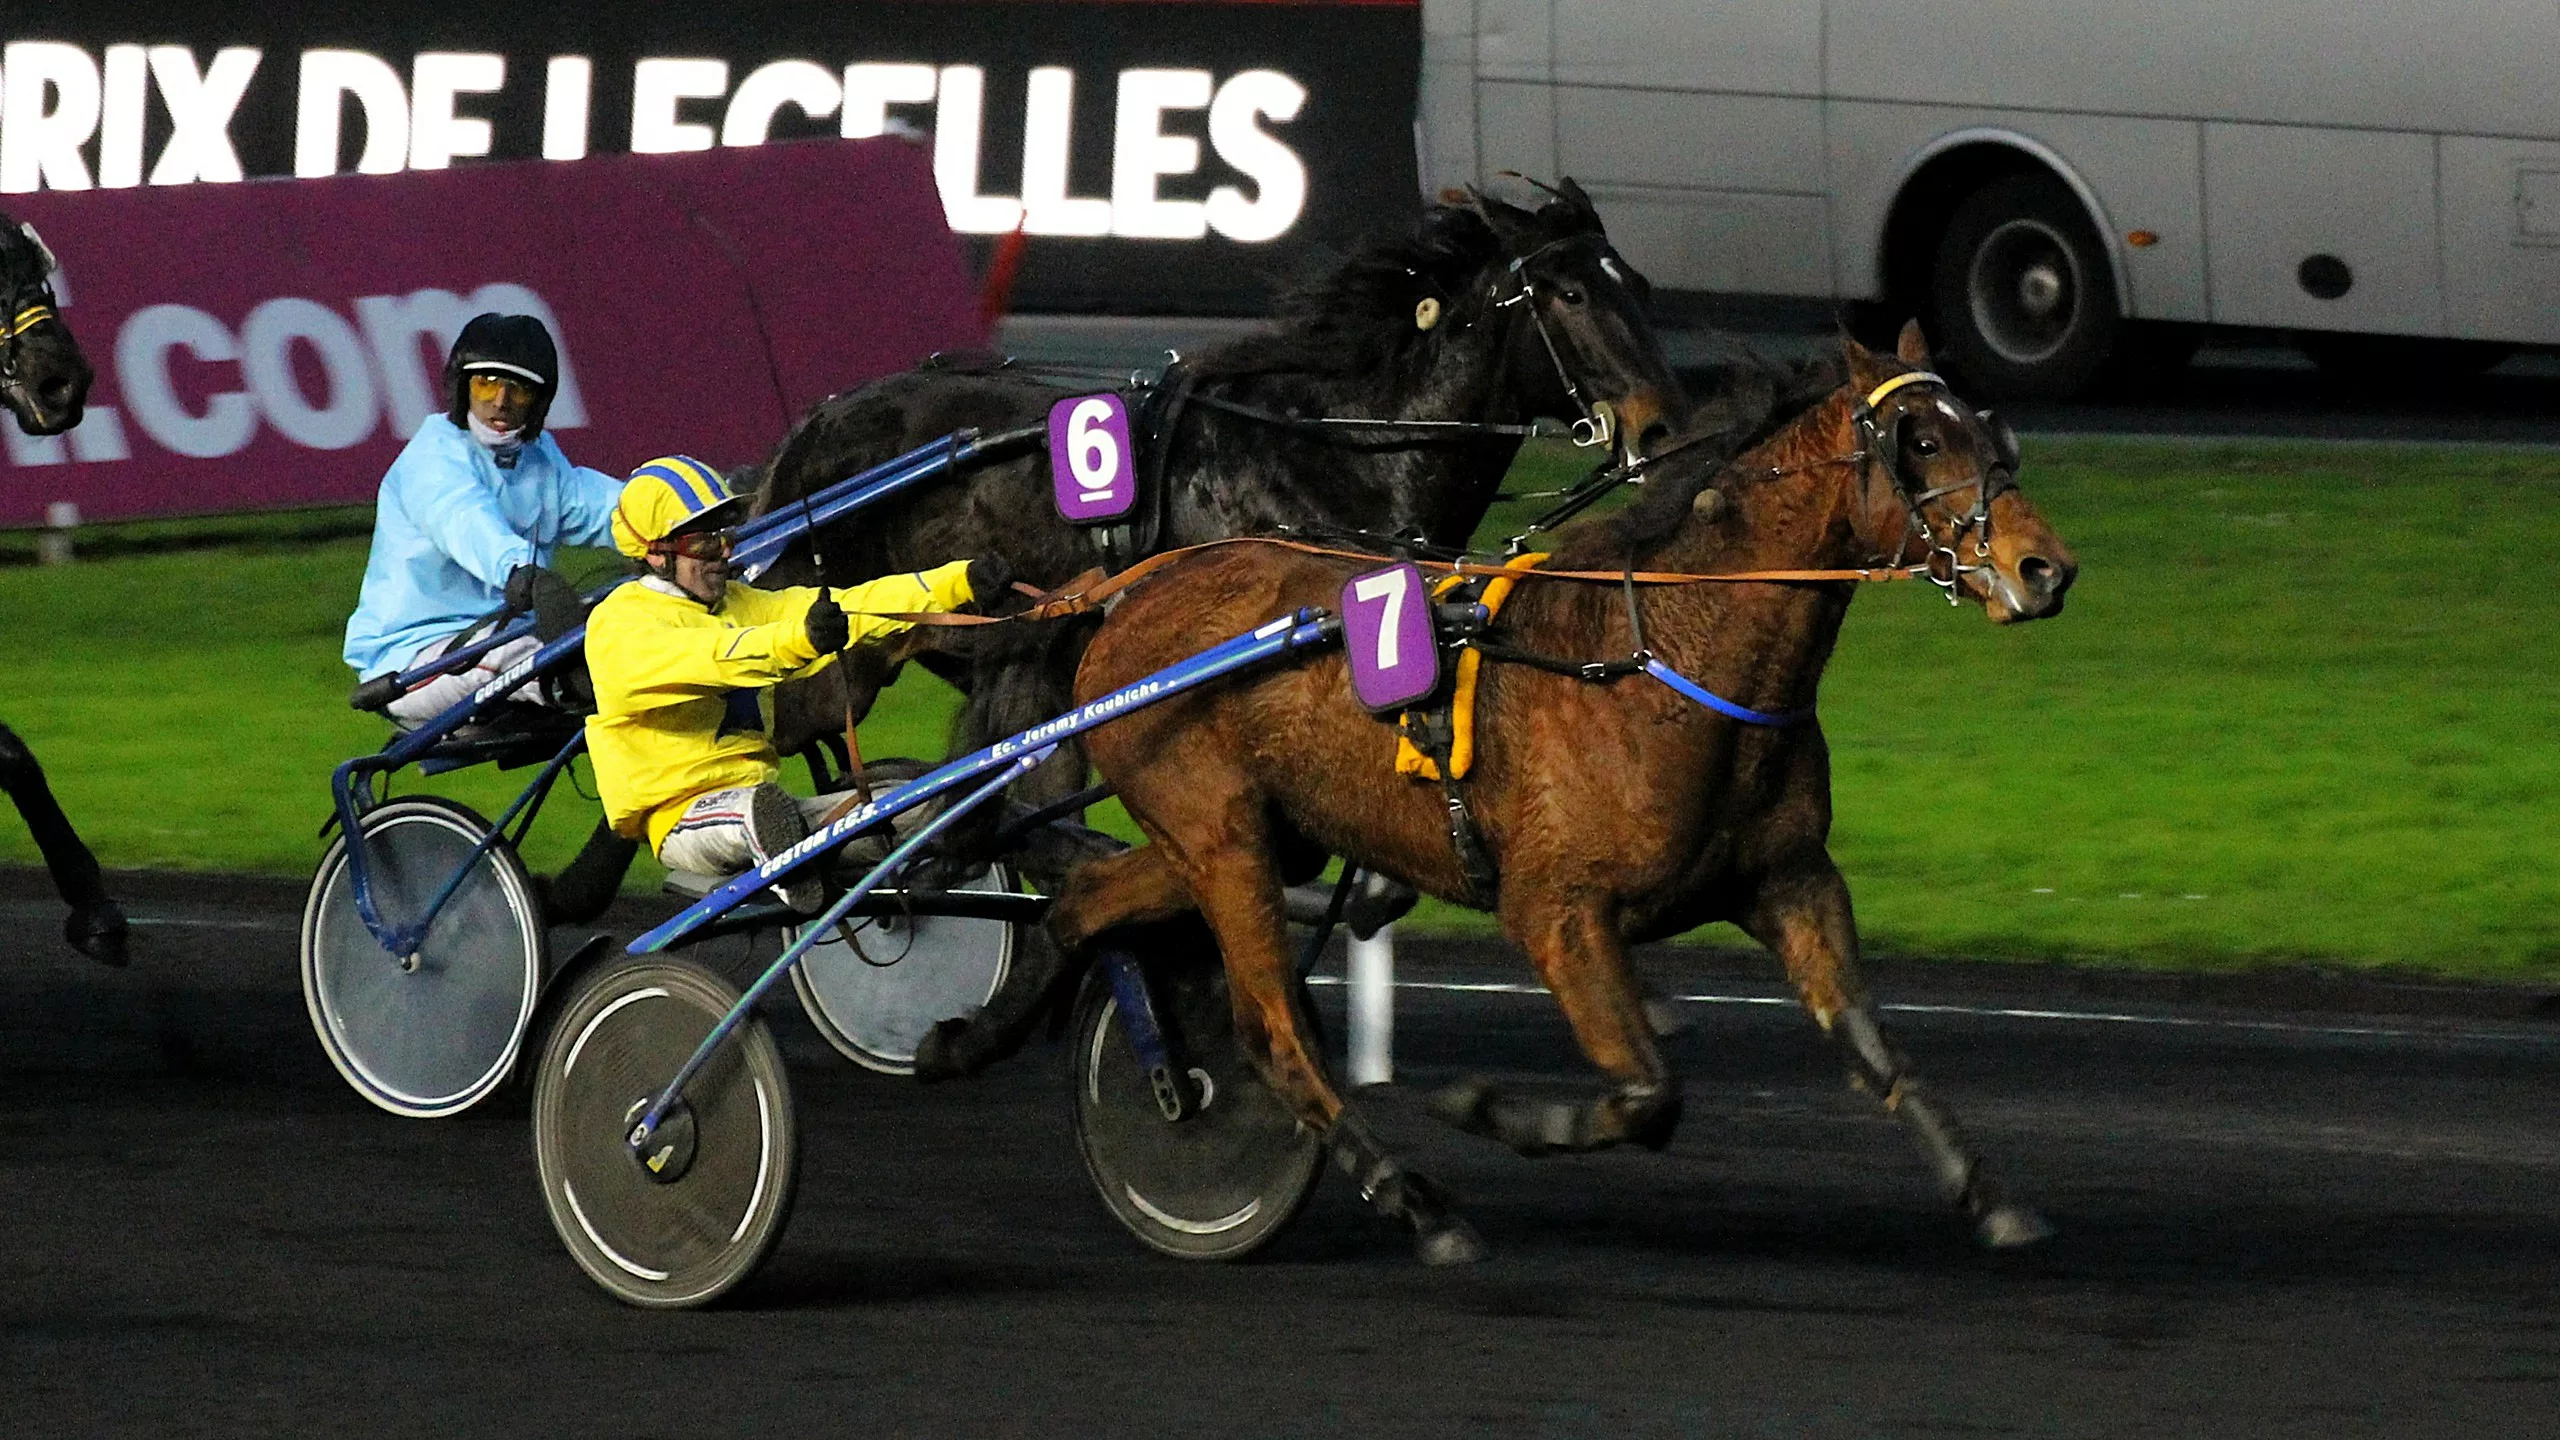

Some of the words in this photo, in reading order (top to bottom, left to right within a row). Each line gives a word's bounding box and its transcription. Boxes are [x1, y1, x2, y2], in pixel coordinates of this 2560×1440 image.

[0, 40, 263, 194] RIX
[294, 47, 504, 178] DE
[1066, 398, 1119, 490] 6
[1355, 568, 1407, 670] 7
[1021, 712, 1080, 745] Jeremy
